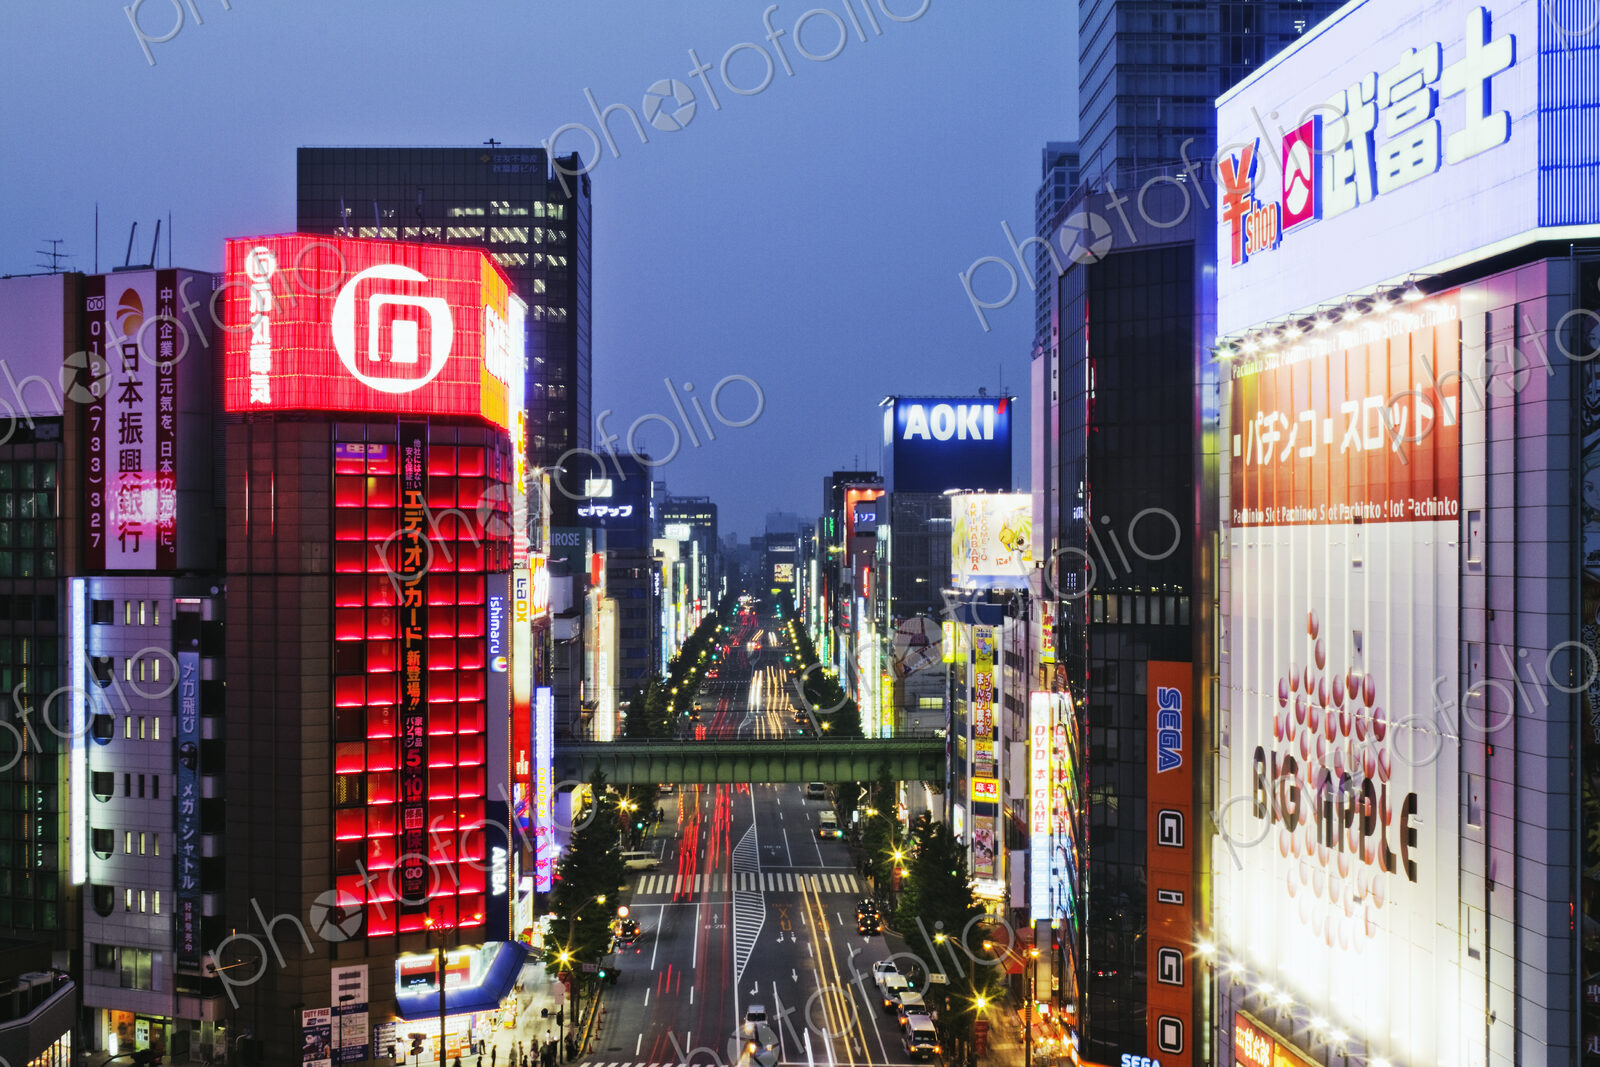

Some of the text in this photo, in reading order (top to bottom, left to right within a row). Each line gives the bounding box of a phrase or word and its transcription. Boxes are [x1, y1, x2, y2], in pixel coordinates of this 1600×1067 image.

[1321, 6, 1516, 220] 武富士
[118, 344, 144, 553] 日本振興銀行
[903, 404, 994, 441] AOKI
[970, 502, 979, 571] AKIHABARA
[490, 596, 503, 654] ishimaru
[1157, 686, 1182, 774] SEGA
[538, 767, 546, 818] ONODEN
